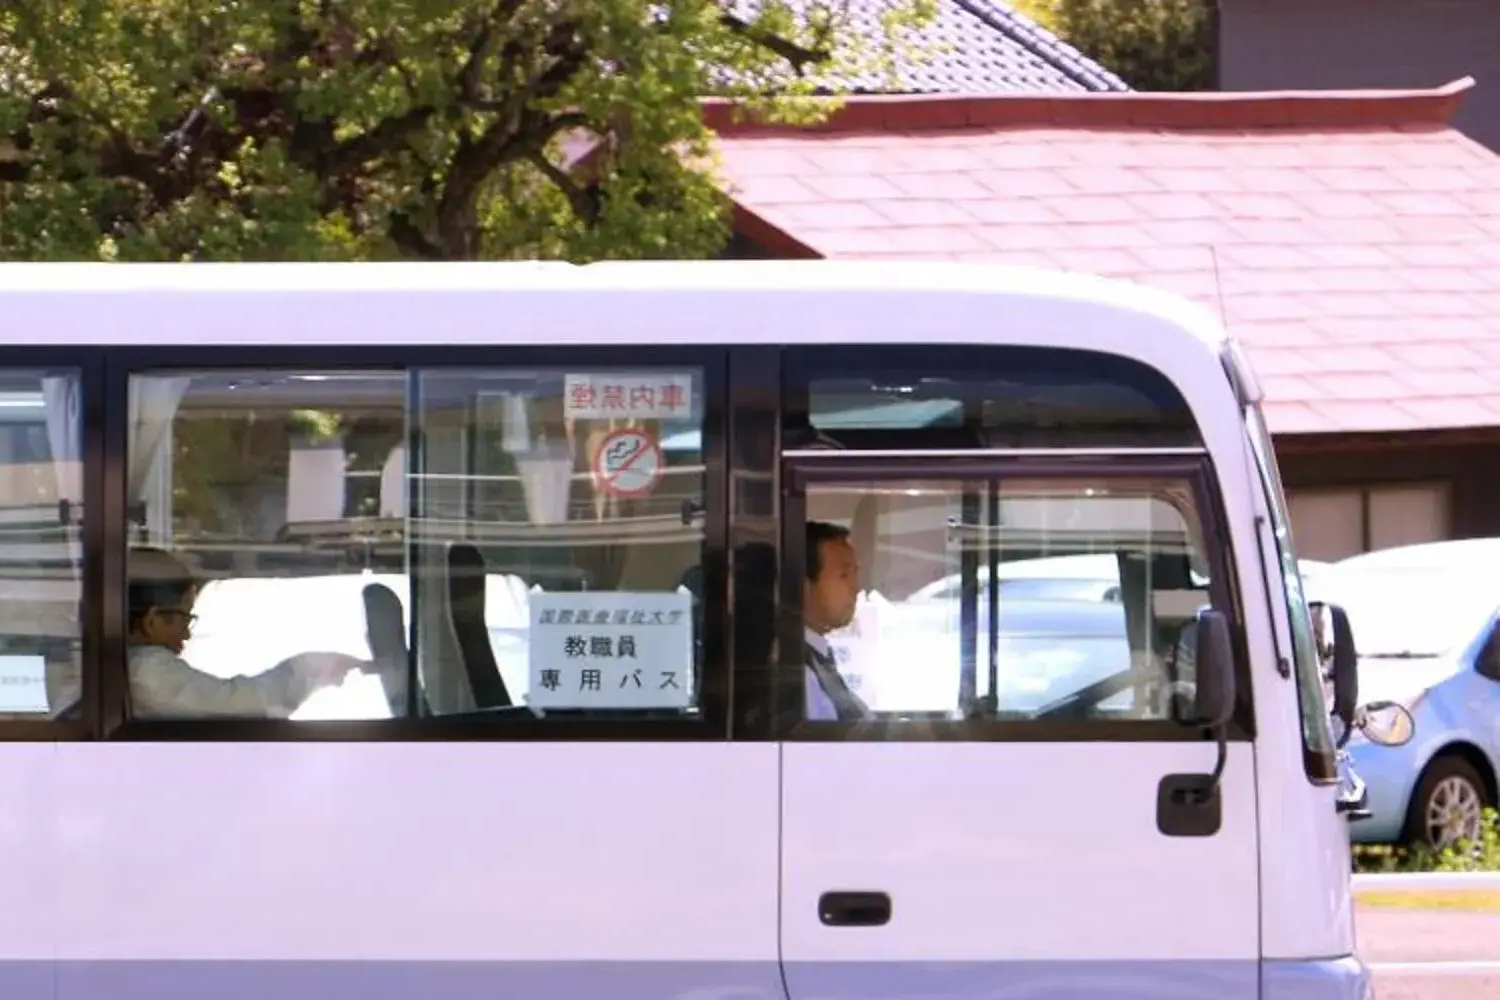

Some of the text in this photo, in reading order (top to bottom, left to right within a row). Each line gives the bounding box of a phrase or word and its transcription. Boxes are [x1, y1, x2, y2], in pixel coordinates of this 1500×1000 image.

[564, 634, 636, 658] 教職員
[539, 667, 679, 692] 専用バス
